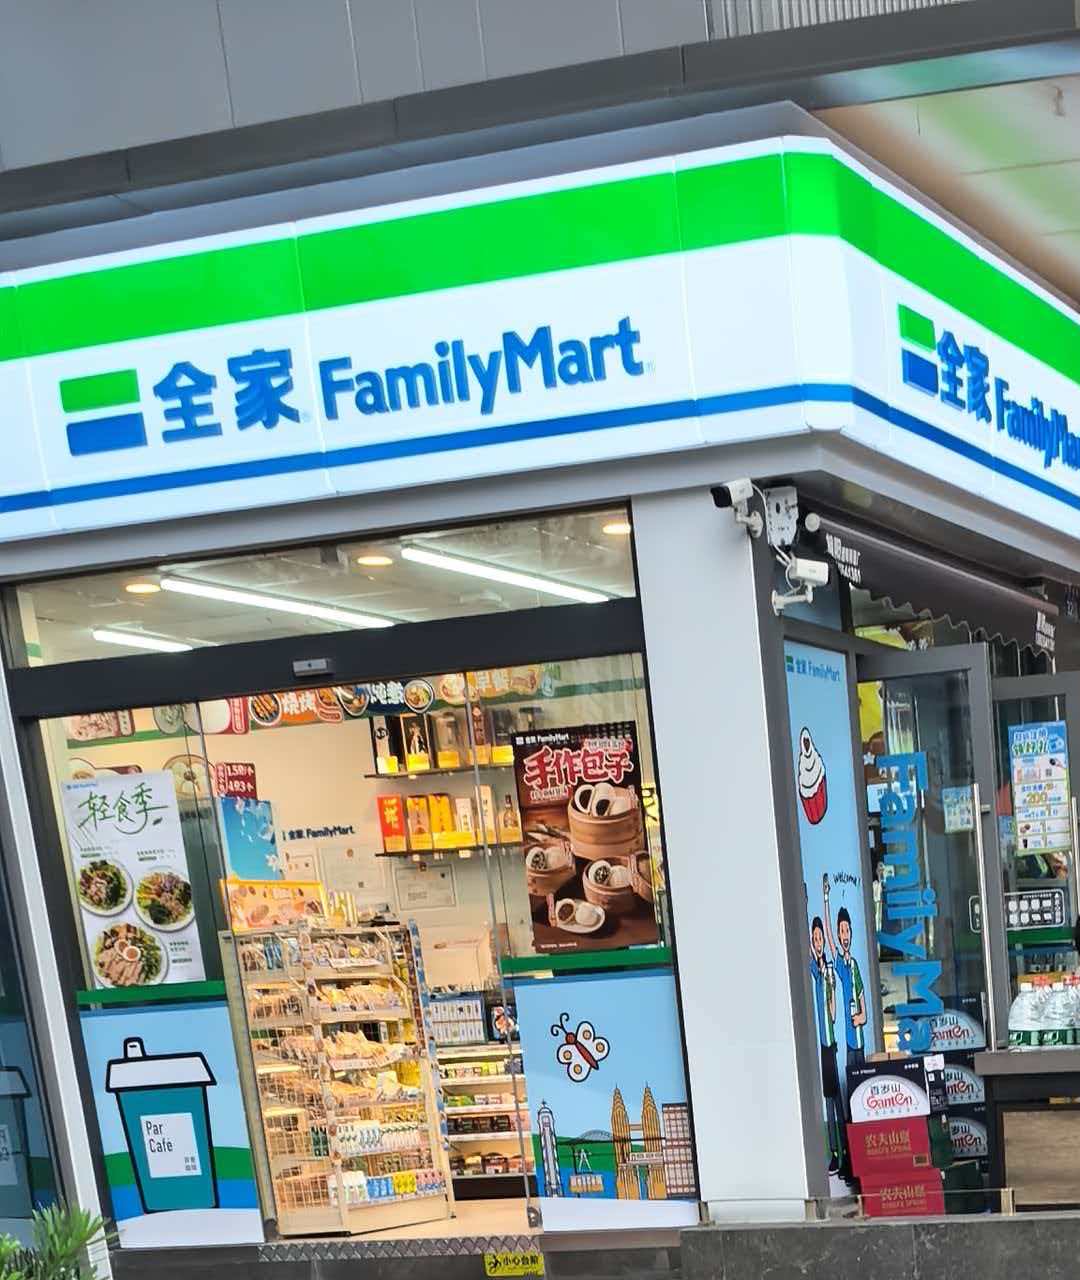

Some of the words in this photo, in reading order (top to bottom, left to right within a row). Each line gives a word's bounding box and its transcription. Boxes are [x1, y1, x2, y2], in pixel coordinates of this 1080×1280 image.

[153, 348, 300, 444] 全家
[319, 317, 643, 419] FamilyMart
[936, 330, 992, 424] 全家
[524, 746, 634, 792] 手作包子
[76, 782, 168, 834] 轻食季
[306, 825, 355, 839] FamilyMart
[870, 1083, 901, 1095] 百岁山
[145, 1121, 163, 1135] Par
